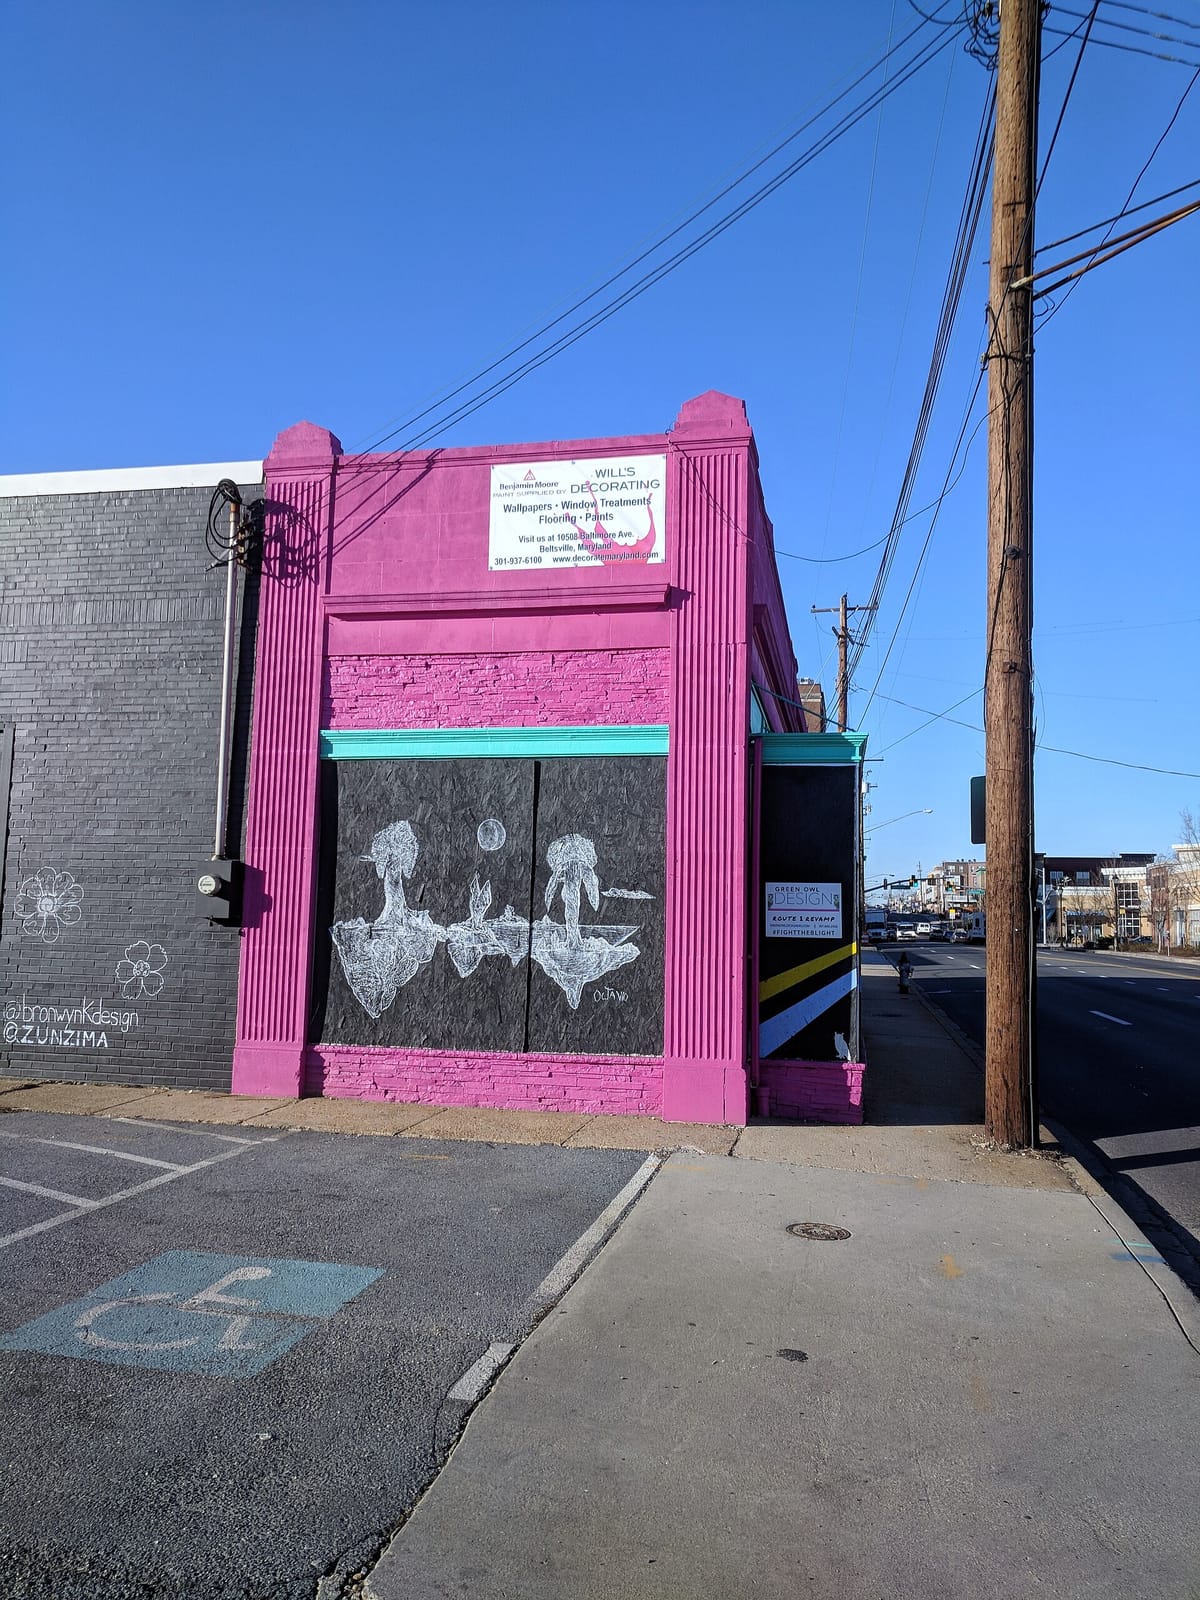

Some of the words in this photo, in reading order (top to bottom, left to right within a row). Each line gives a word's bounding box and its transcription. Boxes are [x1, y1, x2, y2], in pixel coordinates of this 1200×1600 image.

[595, 466, 636, 479] WILL'S
[499, 481, 534, 491] Benjamin
[570, 479, 661, 494] DECORATING
[516, 489, 555, 497] SUPPLIED
[503, 502, 553, 514] Wallpapers
[561, 500, 597, 511] Window
[601, 497, 651, 508] Treatments
[538, 513, 577, 525] Flooring
[585, 511, 614, 522] Paints
[518, 535, 535, 543] Visit
[547, 534, 555, 542] at
[557, 533, 578, 541] 10508
[580, 531, 617, 540] Baltimore
[617, 530, 634, 538] Ave.
[539, 543, 576, 553] Beltsville,
[577, 542, 612, 551] Maryland
[494, 556, 543, 565] 301-937-6100
[552, 551, 659, 563] www.decoratemaryland.com
[774, 892, 833, 905] DESIGN
[3, 1021, 109, 1048] @ZUNZIMA
